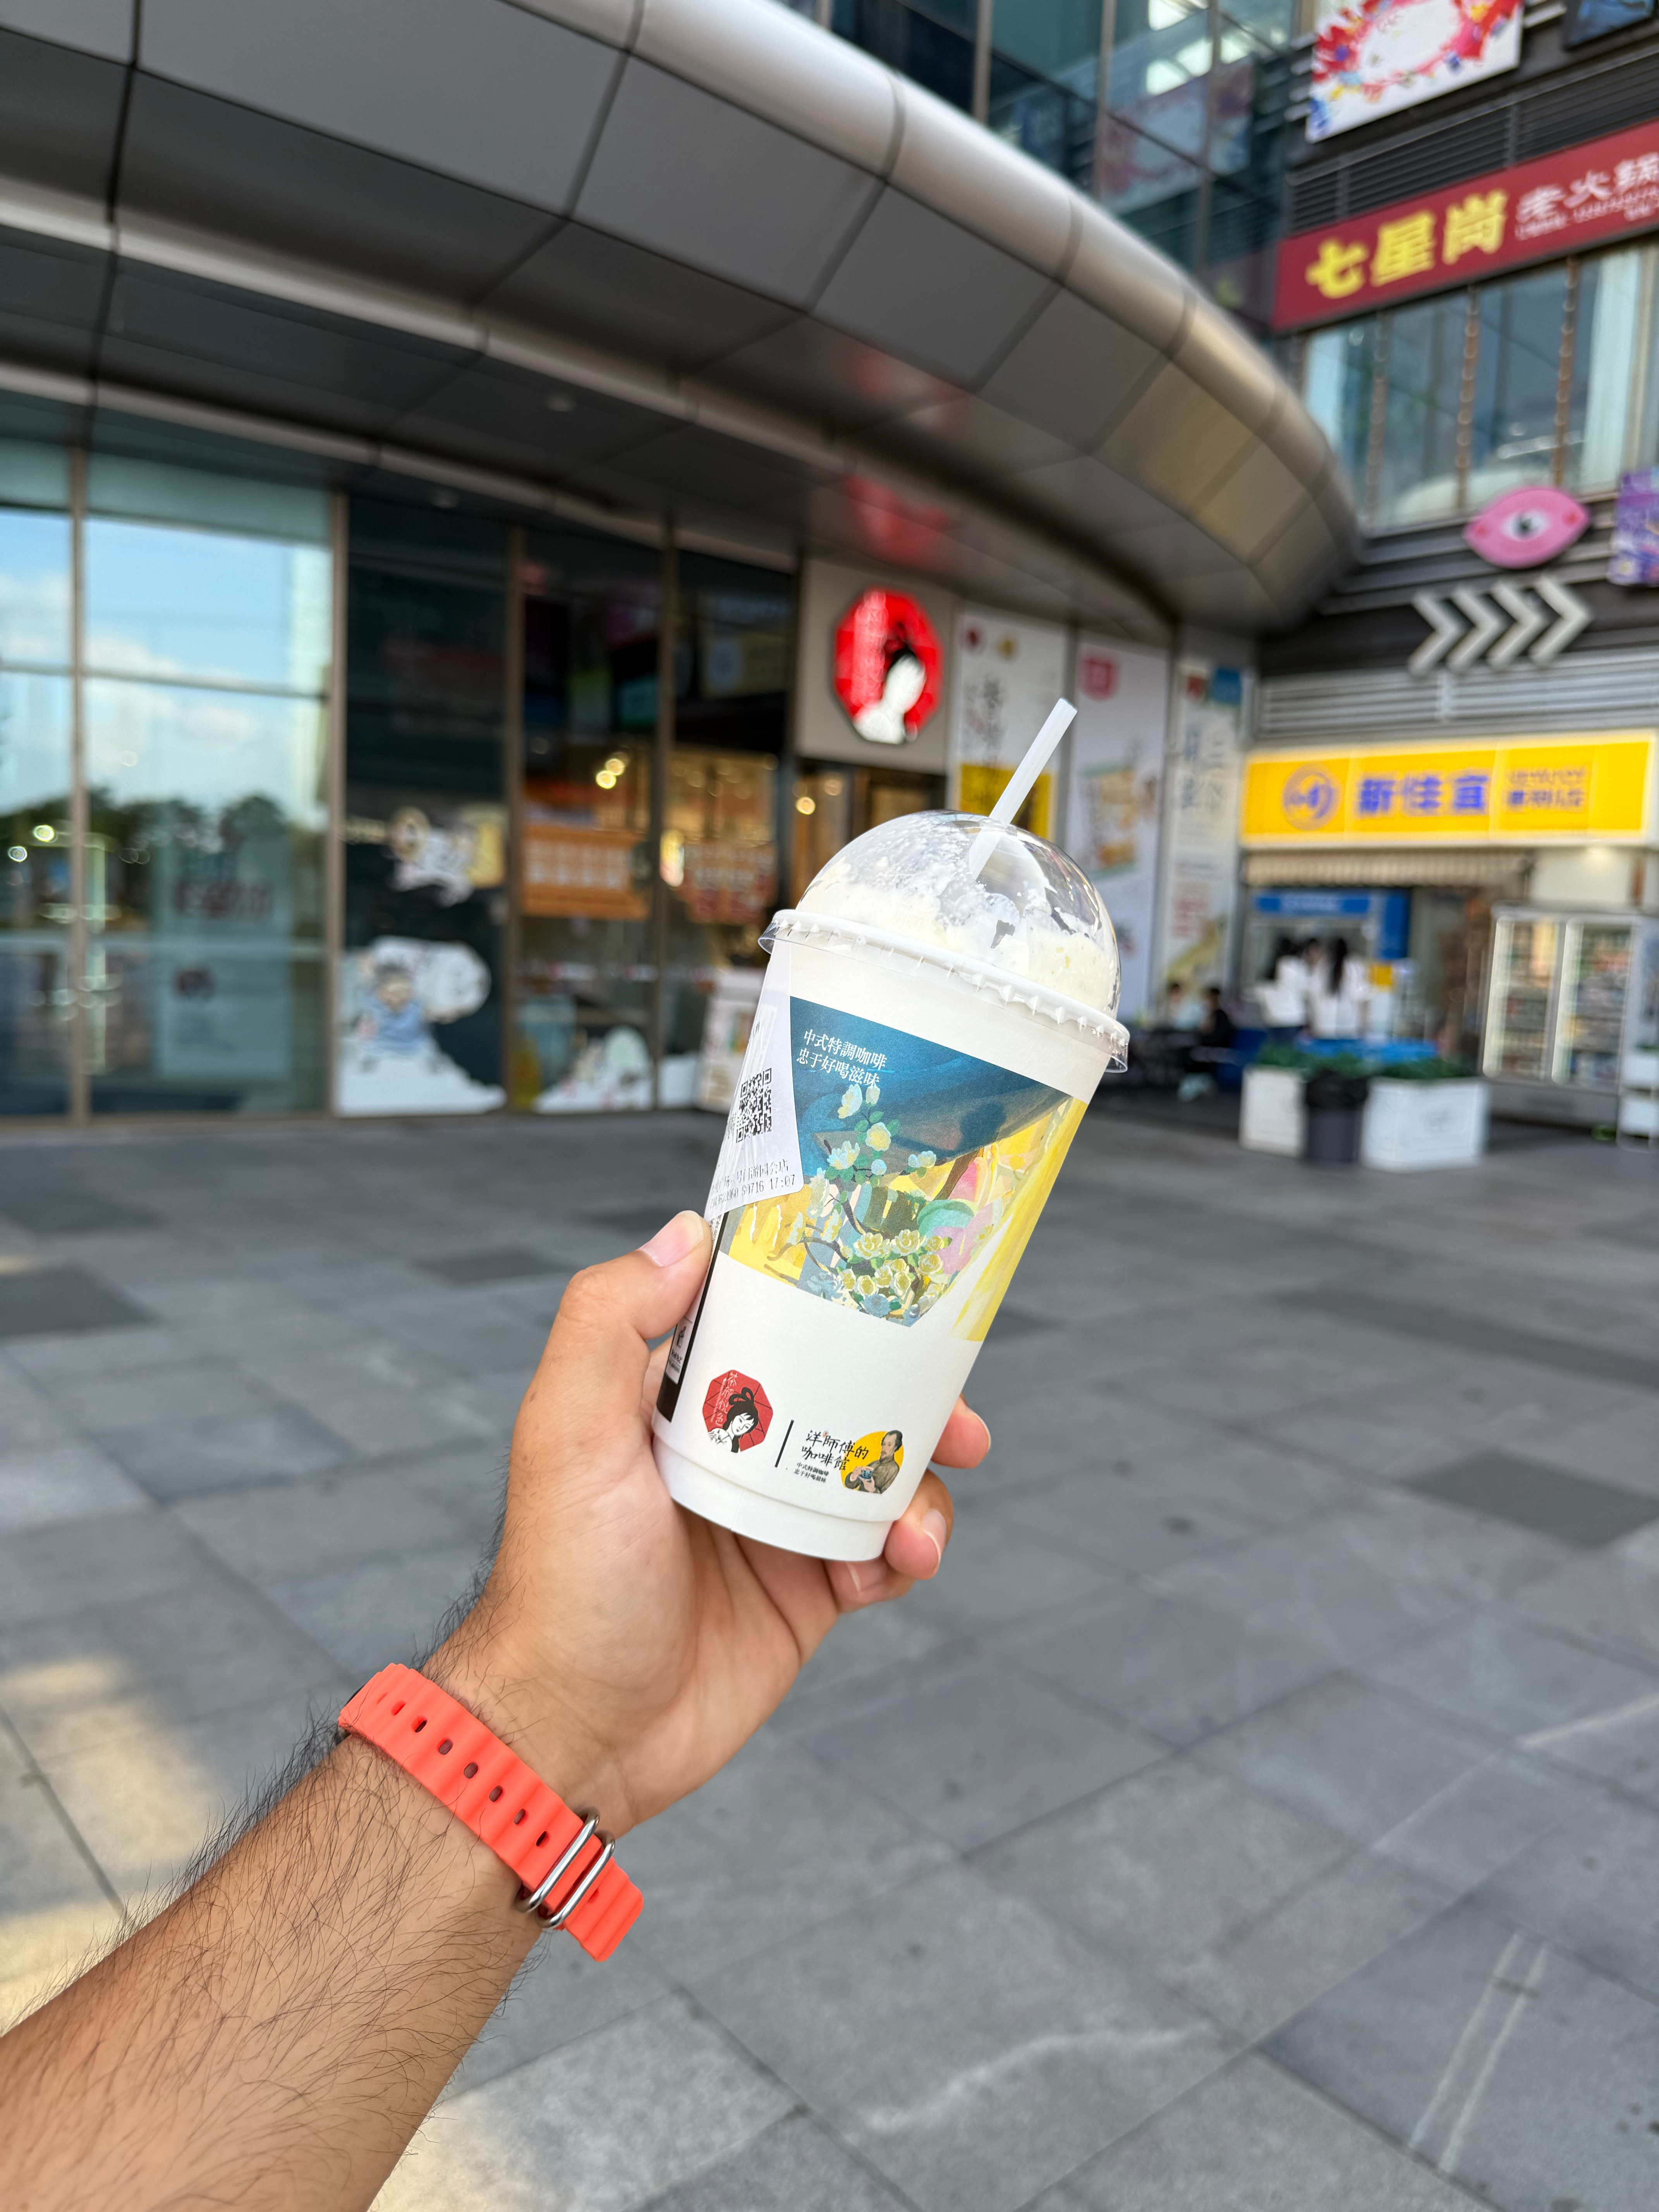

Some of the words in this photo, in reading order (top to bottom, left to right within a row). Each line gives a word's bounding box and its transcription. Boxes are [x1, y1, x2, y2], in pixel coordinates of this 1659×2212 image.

[804, 1029, 887, 1070] 中式特調咖啡
[797, 1048, 879, 1087] 忠于好喝滋味
[771, 1174, 795, 1190] 17:07
[802, 1446, 850, 1470] 咖啡館
[806, 1430, 869, 1460] 洋師傅的
